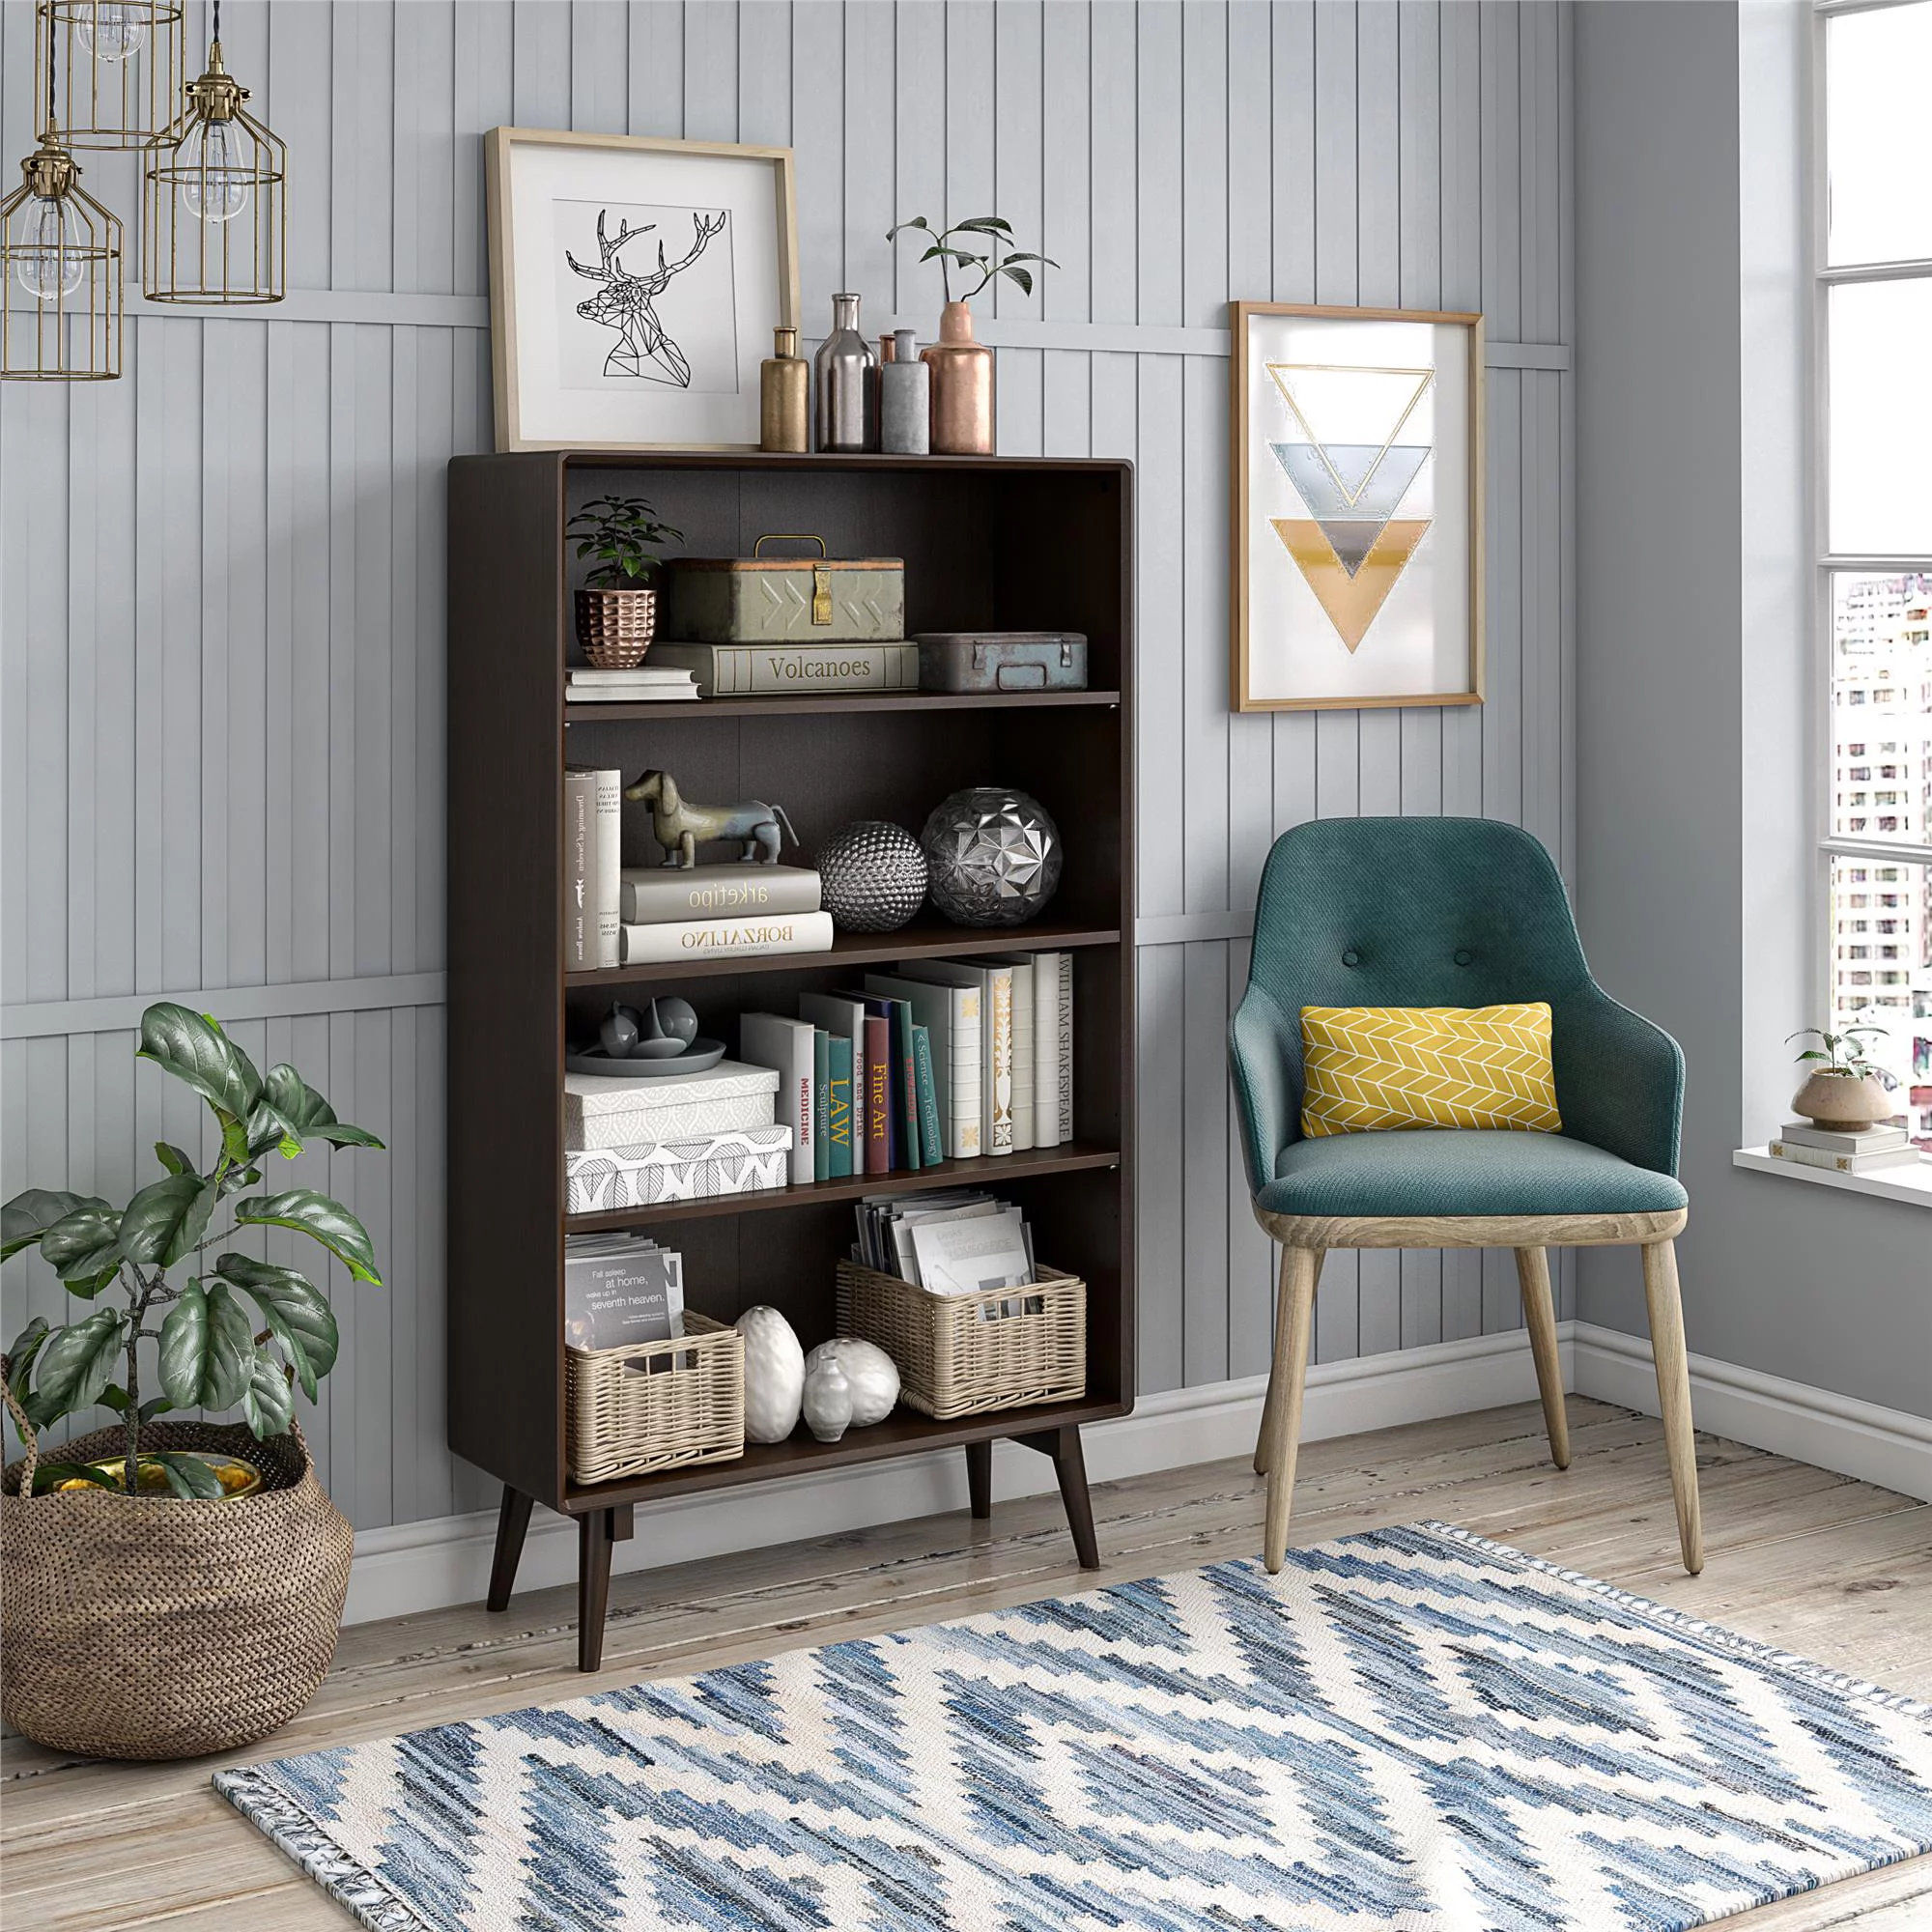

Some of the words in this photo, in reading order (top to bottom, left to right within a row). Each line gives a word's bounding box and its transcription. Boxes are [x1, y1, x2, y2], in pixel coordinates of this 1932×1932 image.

[768, 656, 871, 680] Volcanoes
[1059, 958, 1069, 1027] WILLIAM
[873, 1062, 887, 1104] Fine
[918, 1045, 929, 1086] Science
[1059, 1032, 1069, 1136] SHAKESPEARE
[801, 1077, 810, 1146] MEDICINE
[817, 1083, 828, 1137] Sculpture
[830, 1078, 850, 1147] LAW
[872, 1108, 886, 1140] Art
[923, 1096, 938, 1158] Technology
[591, 1297, 626, 1310] seventh
[629, 1293, 666, 1306] heaven.
[606, 1279, 615, 1289] at
[617, 1276, 648, 1287] home,
